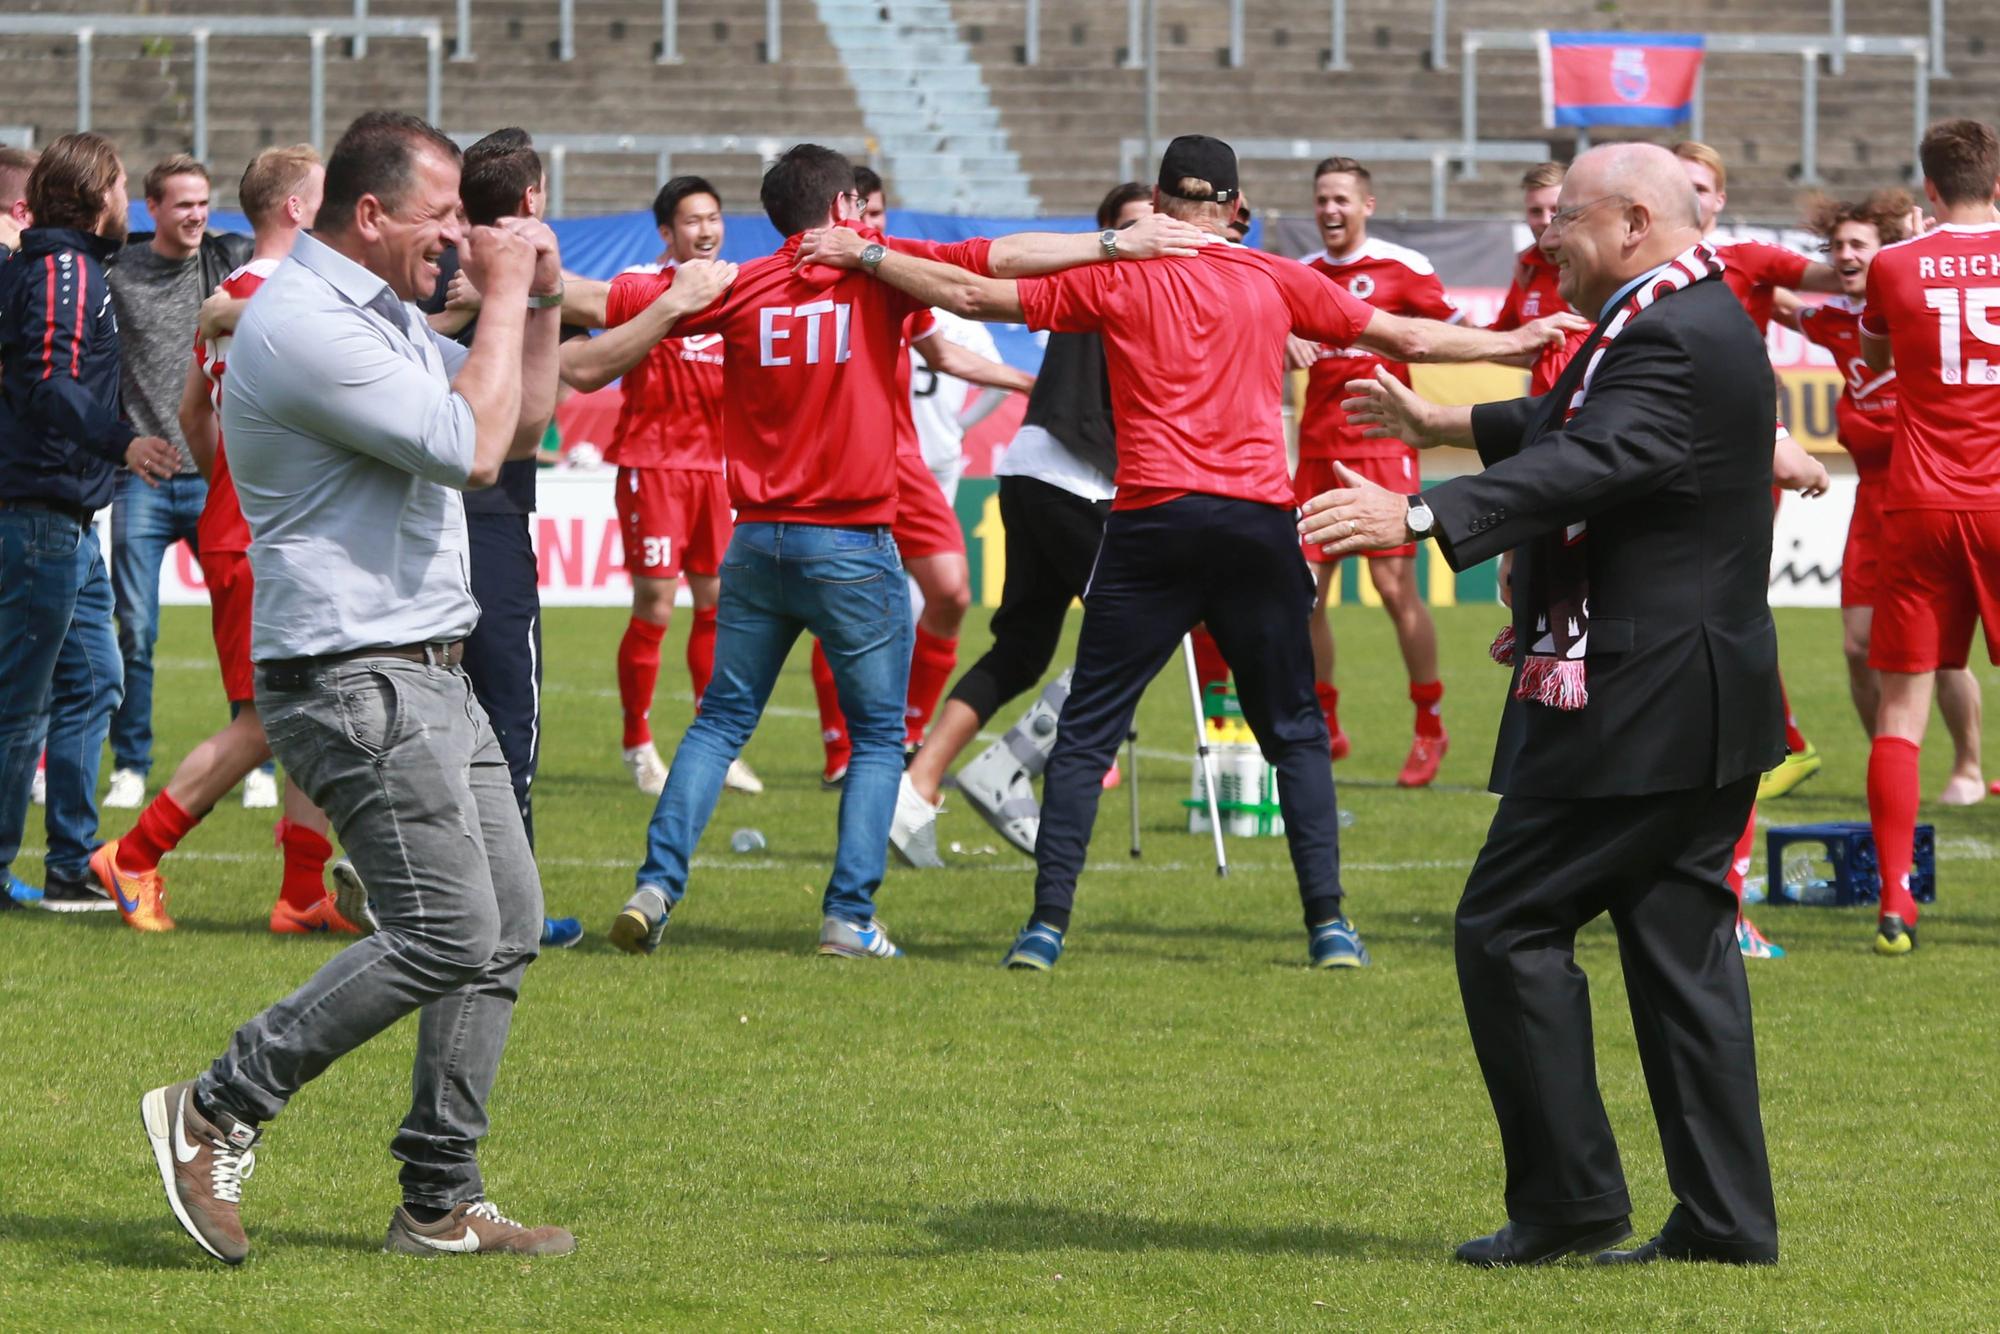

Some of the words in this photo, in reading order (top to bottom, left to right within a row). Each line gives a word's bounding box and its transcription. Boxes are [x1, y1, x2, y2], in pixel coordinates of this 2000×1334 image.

[760, 299, 852, 367] ETL
[1923, 287, 2000, 385] 15
[643, 535, 671, 567] 31
